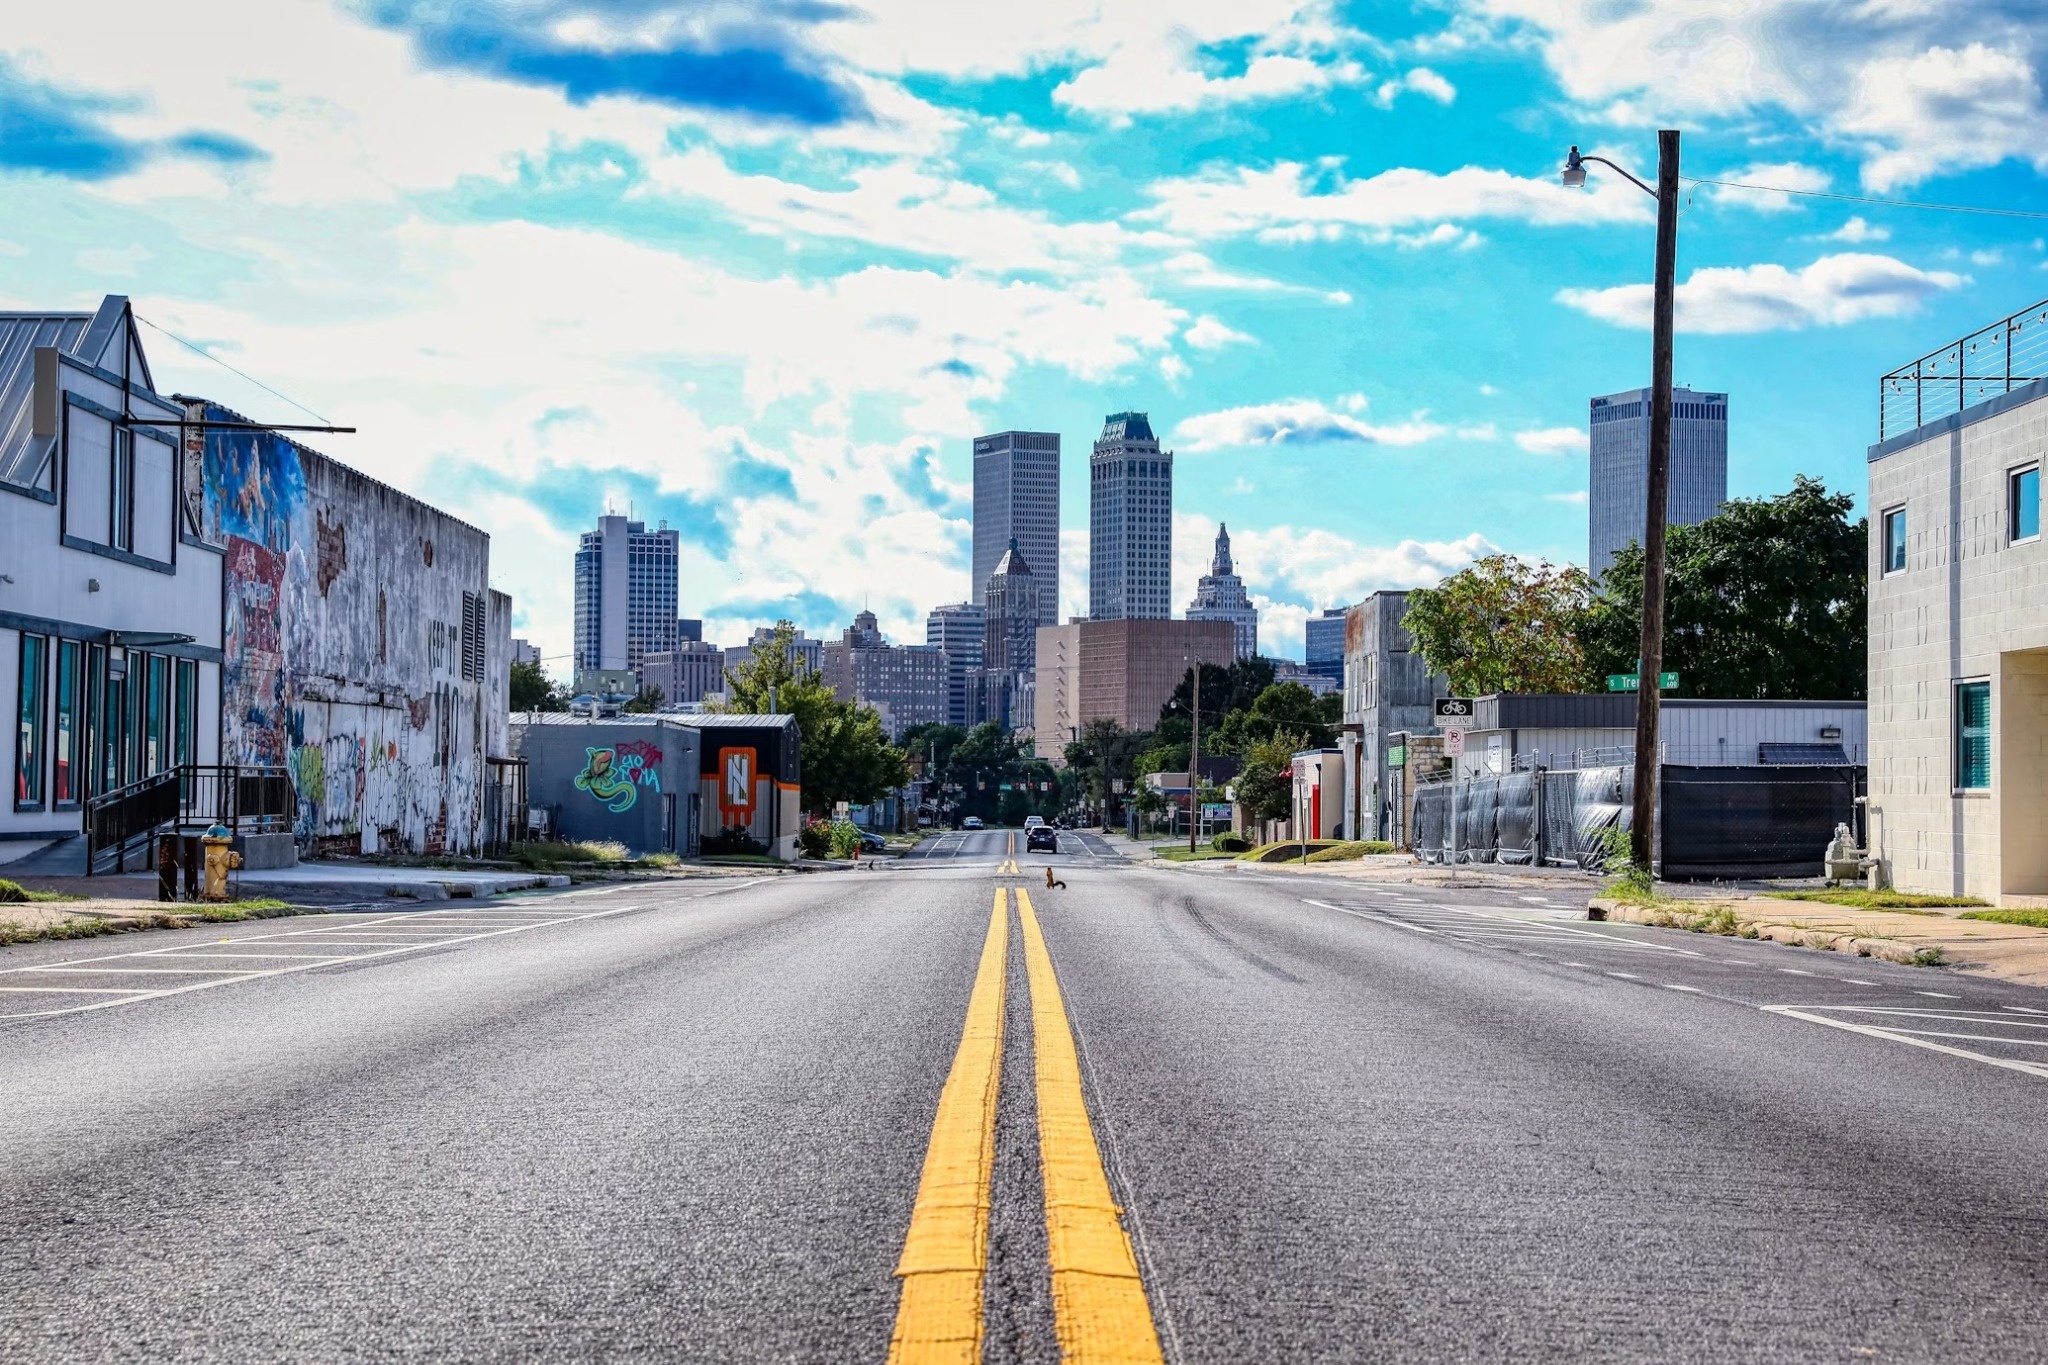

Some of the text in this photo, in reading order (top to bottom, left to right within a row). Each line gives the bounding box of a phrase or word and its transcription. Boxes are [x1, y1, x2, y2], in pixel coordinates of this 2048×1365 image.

[1610, 679, 1615, 687] S
[1667, 673, 1675, 681] Av
[1437, 716, 1471, 725] BIKE LANE
